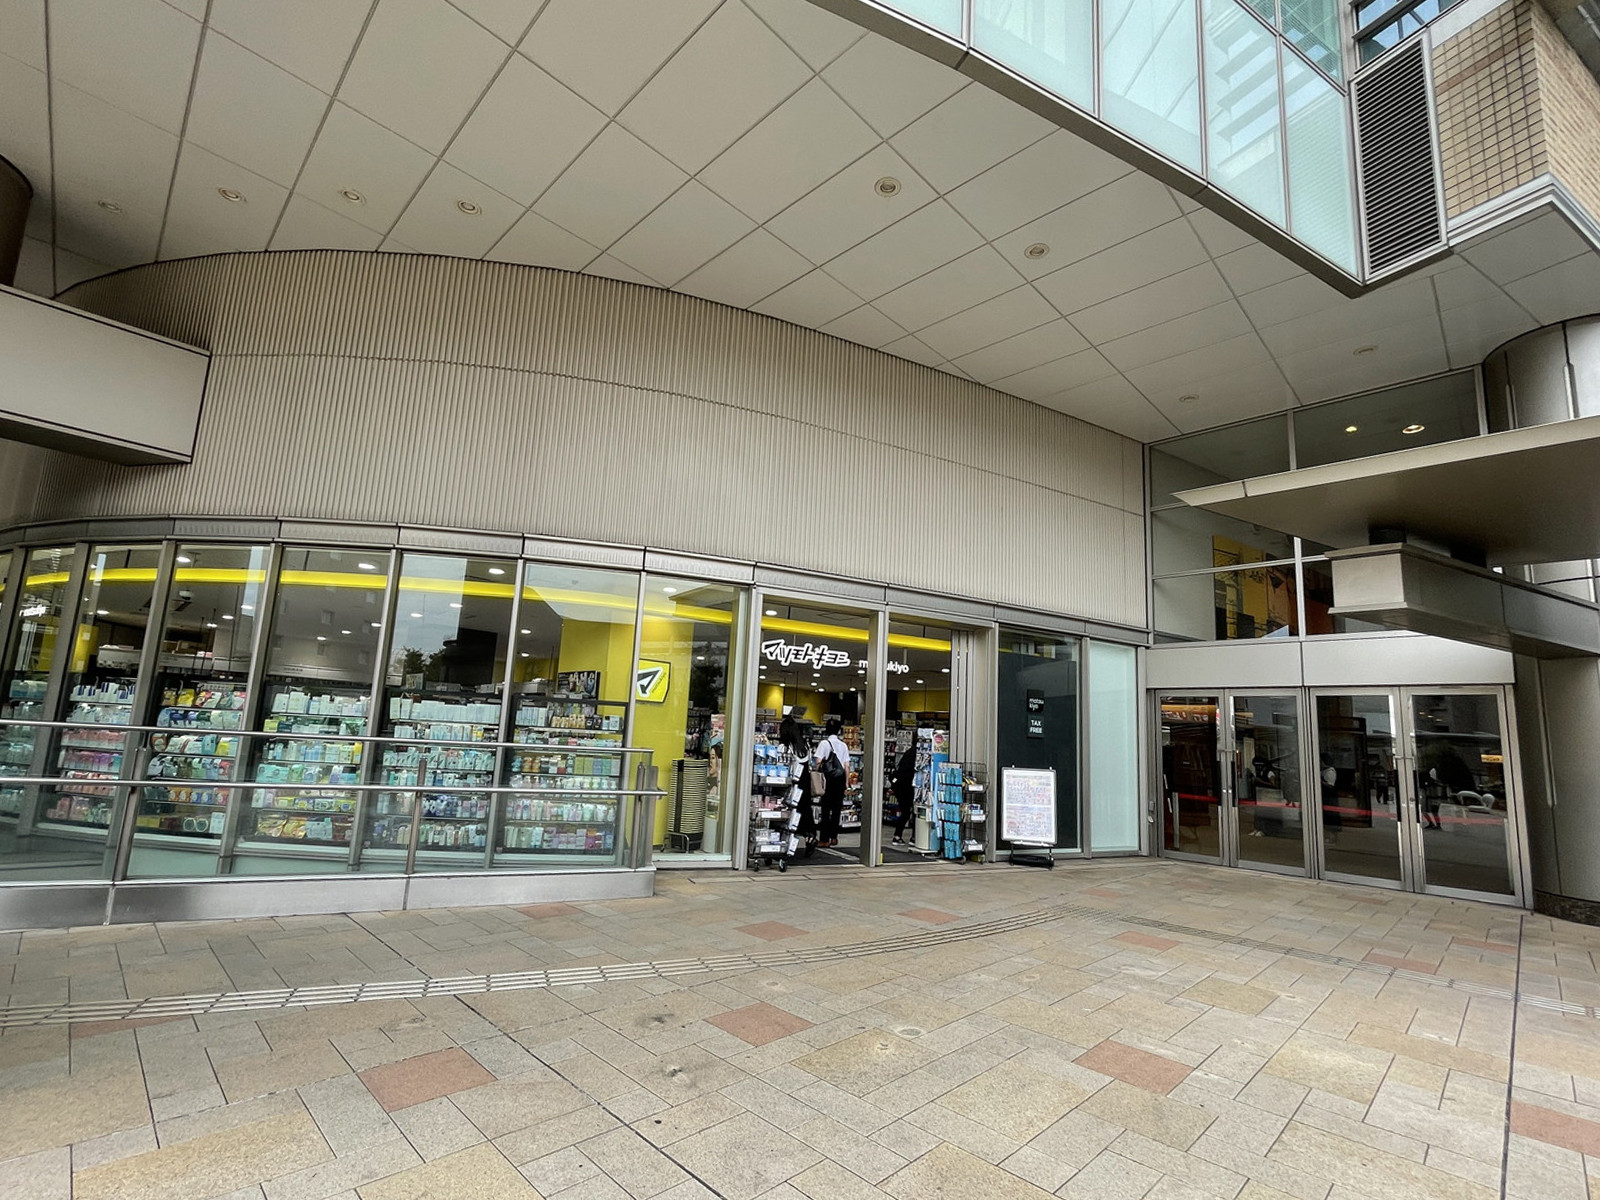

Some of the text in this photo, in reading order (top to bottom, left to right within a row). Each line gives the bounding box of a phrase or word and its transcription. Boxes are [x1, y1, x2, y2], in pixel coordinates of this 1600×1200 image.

[762, 639, 851, 669] マツモトキヨシ
[1031, 719, 1042, 727] TAX
[1029, 726, 1043, 734] FREE
